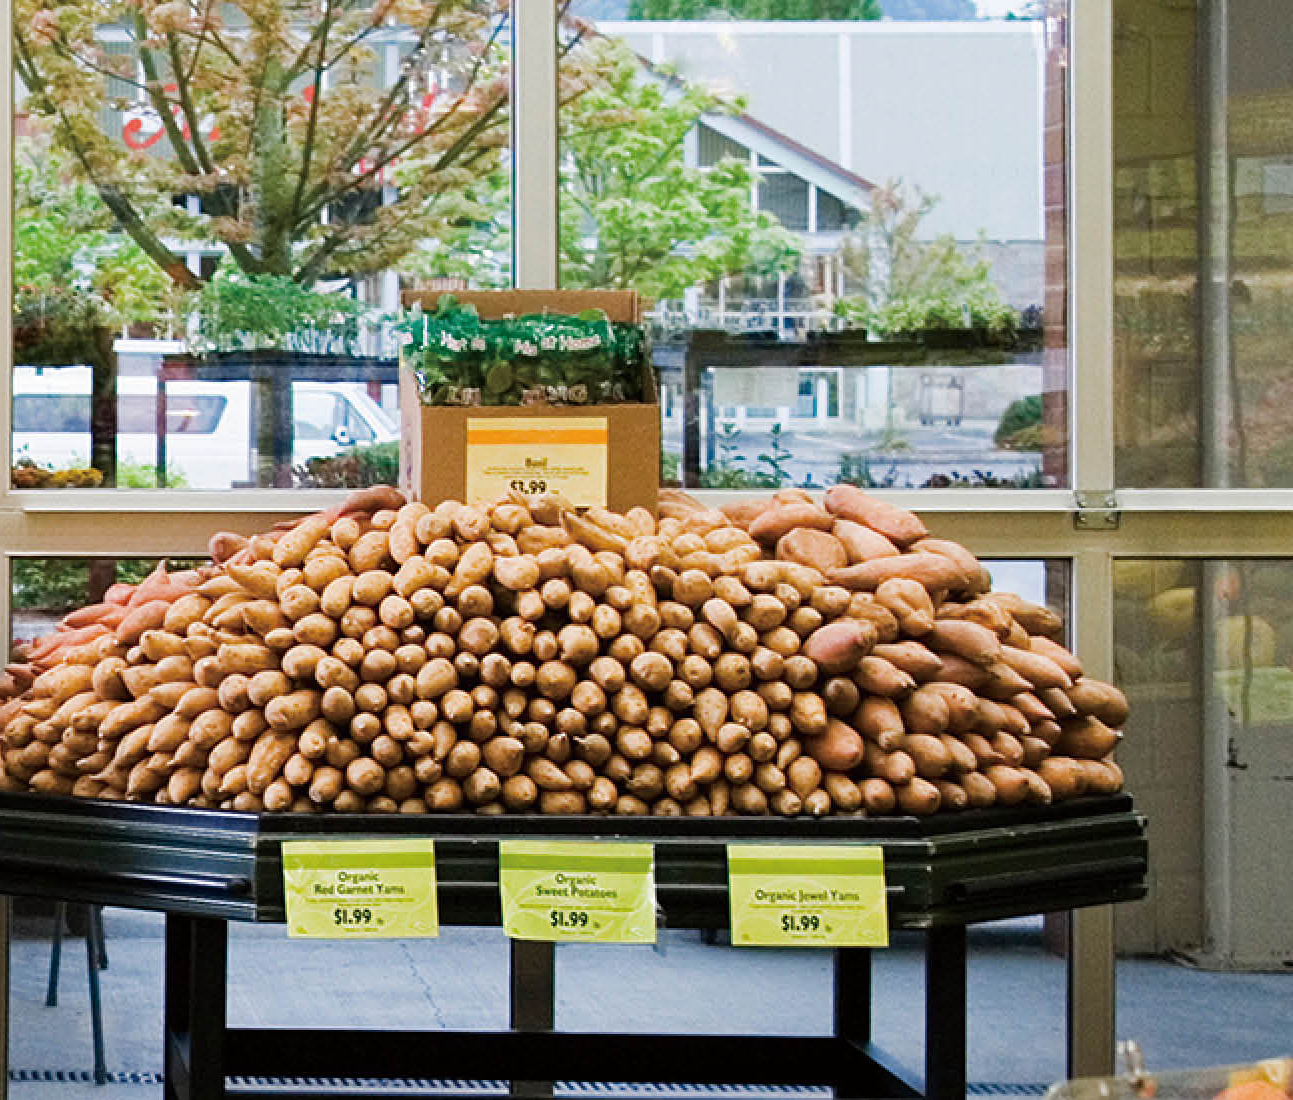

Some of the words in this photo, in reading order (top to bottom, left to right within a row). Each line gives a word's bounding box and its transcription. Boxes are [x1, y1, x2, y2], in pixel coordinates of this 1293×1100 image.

[338, 871, 380, 885] Organic
[554, 873, 598, 886] Organic
[314, 883, 334, 895] Red
[336, 883, 374, 895] Garnet
[376, 883, 406, 895] Yams
[535, 885, 569, 897] Sweet
[570, 884, 618, 899] Potatoes
[754, 888, 797, 903] Organic
[798, 888, 828, 903] Jewel
[829, 888, 860, 901] Yams
[334, 908, 373, 926] $1.99
[550, 911, 589, 928] $1.99
[780, 914, 821, 932] $1.99
